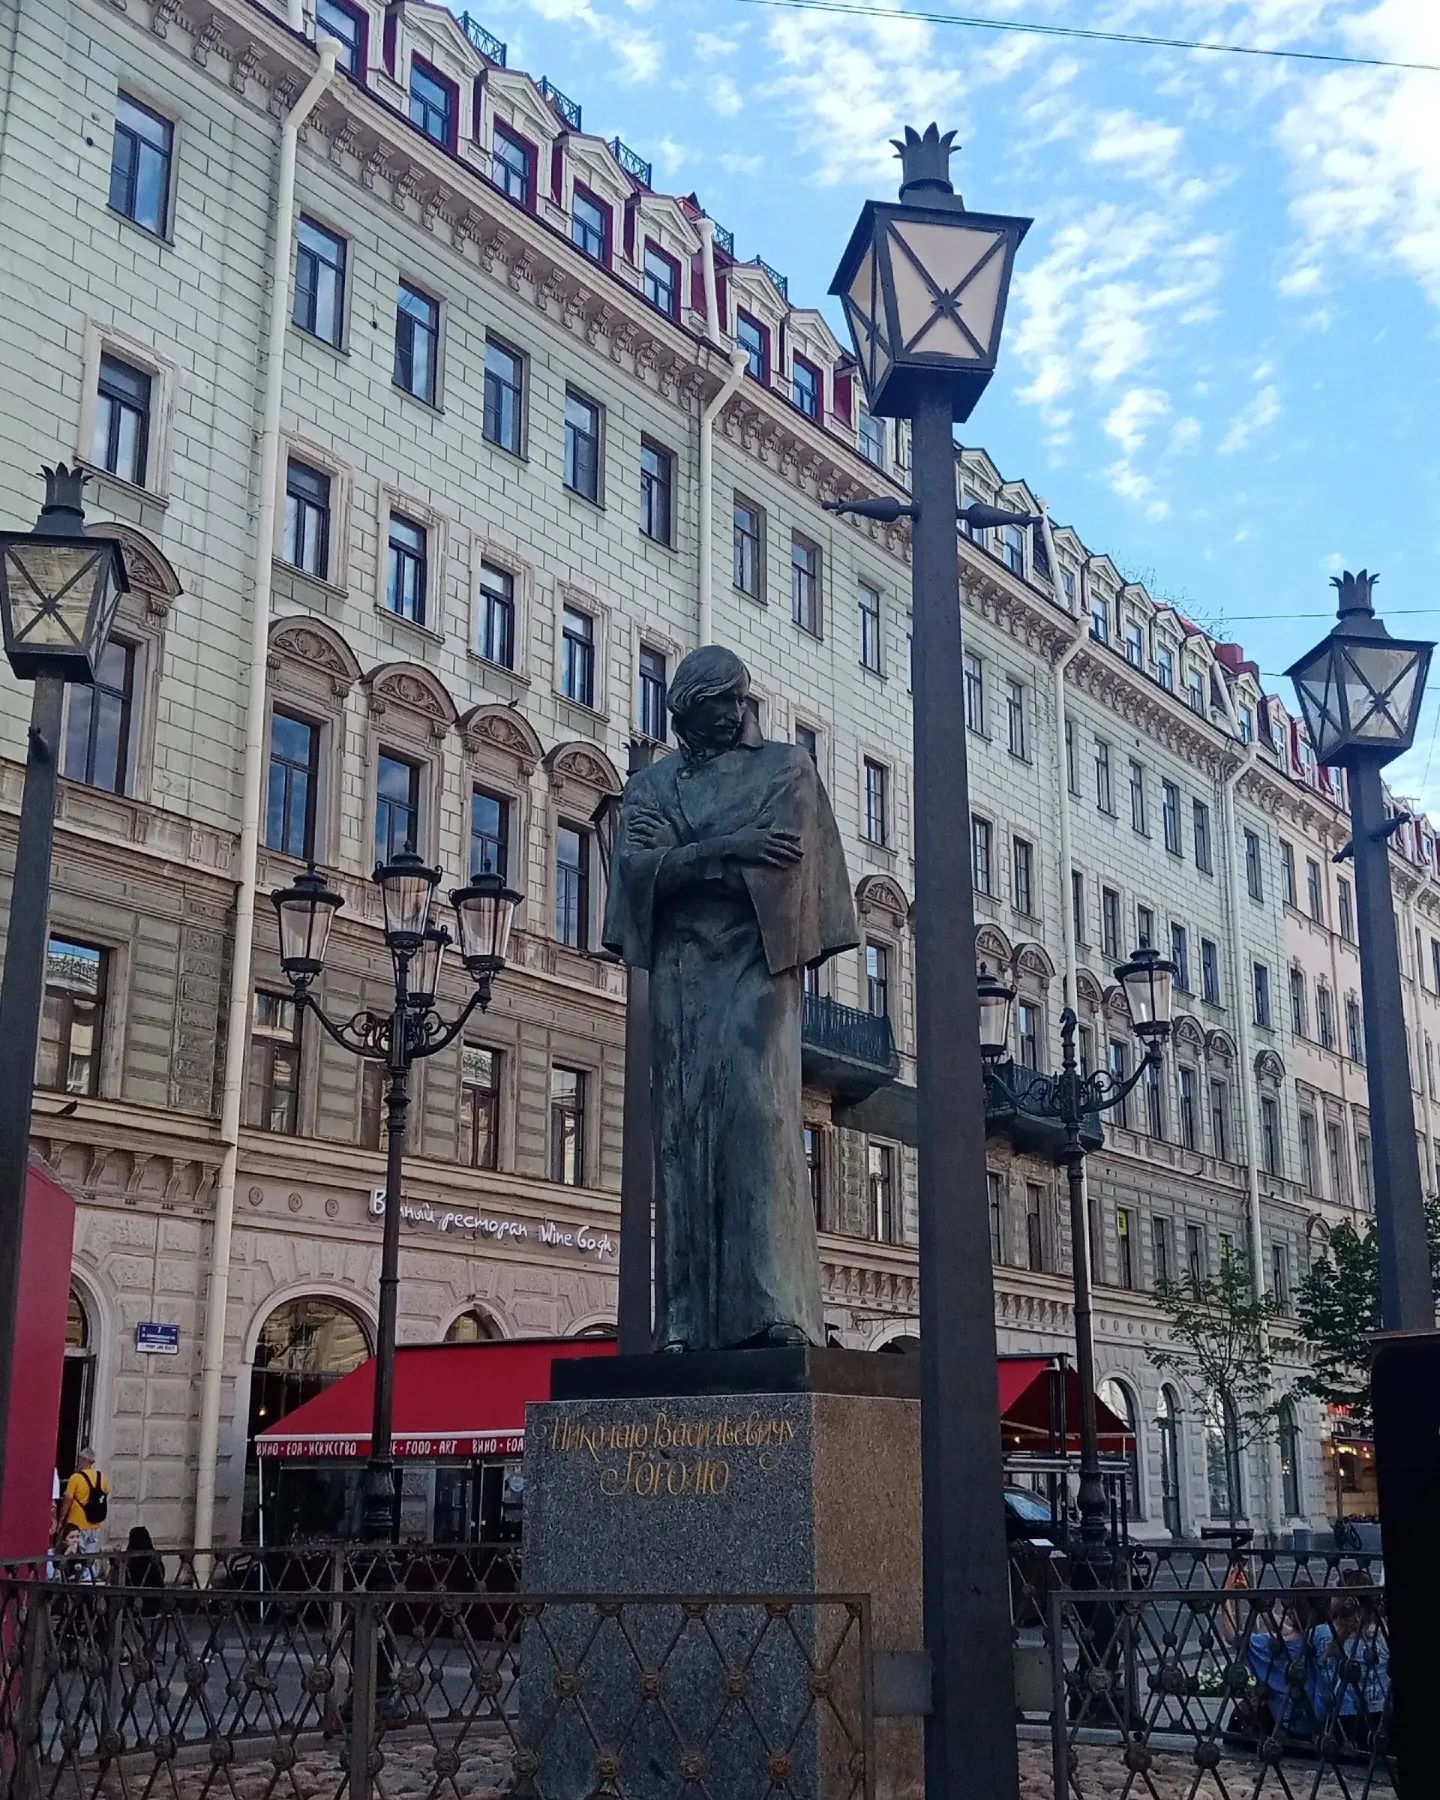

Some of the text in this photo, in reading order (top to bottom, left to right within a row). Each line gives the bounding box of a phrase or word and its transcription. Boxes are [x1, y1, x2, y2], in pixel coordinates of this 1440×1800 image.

[372, 1188, 613, 1259] Вный ресторан Wine Gogh
[256, 1442, 279, 1456] ВИНО
[308, 1441, 357, 1456] ИСКУССТВО
[405, 1440, 431, 1455] FOOD
[439, 1440, 457, 1454] ART
[472, 1438, 497, 1454] ВИНО
[600, 1450, 730, 1496] Гоголю
